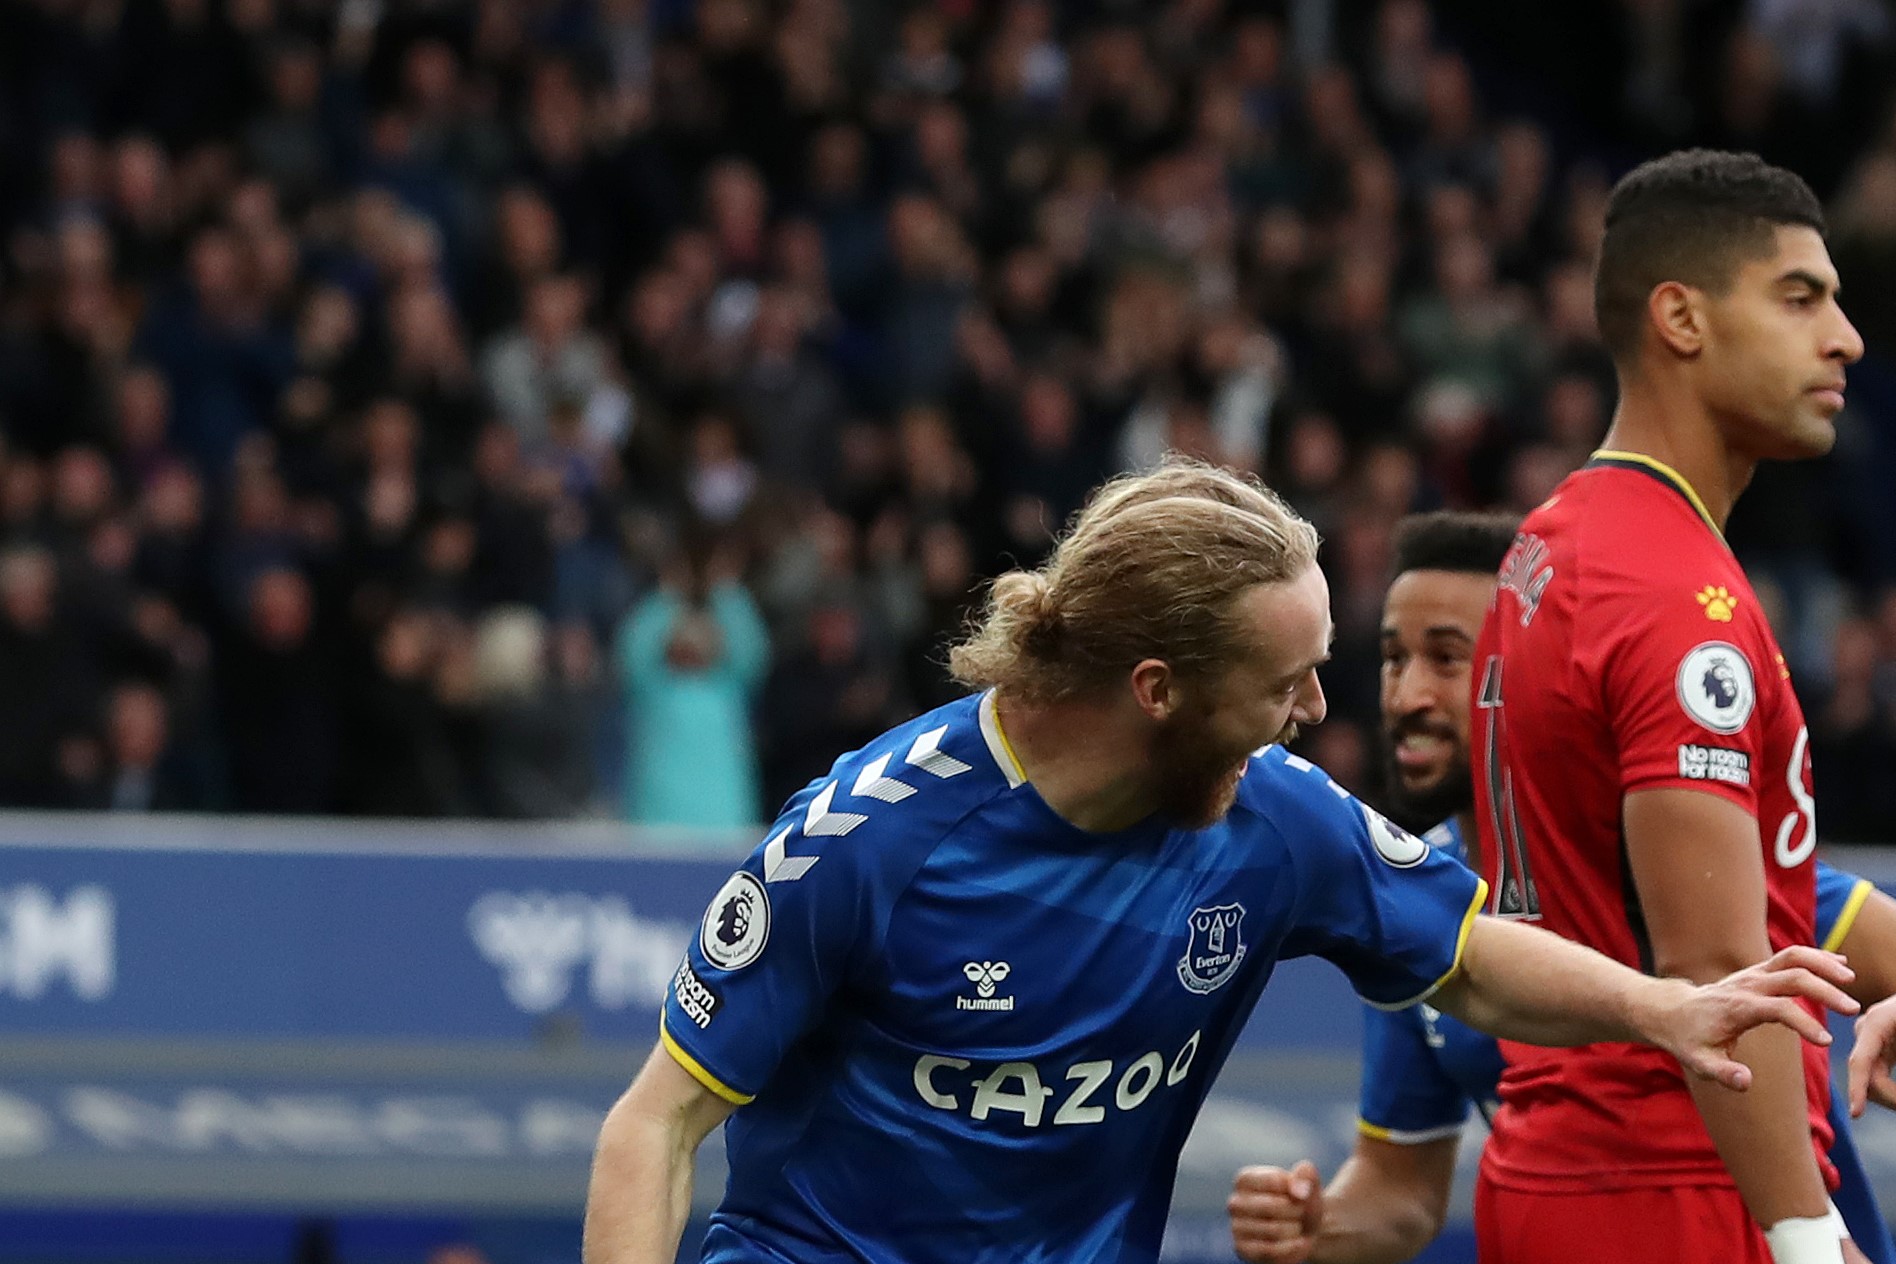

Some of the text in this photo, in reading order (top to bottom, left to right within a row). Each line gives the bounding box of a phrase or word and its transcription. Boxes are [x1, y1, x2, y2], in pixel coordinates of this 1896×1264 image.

[1678, 744, 1709, 763] No
[1195, 954, 1231, 970] Everton
[956, 995, 1014, 1011] hummel
[912, 1029, 1201, 1128] CAZOO
